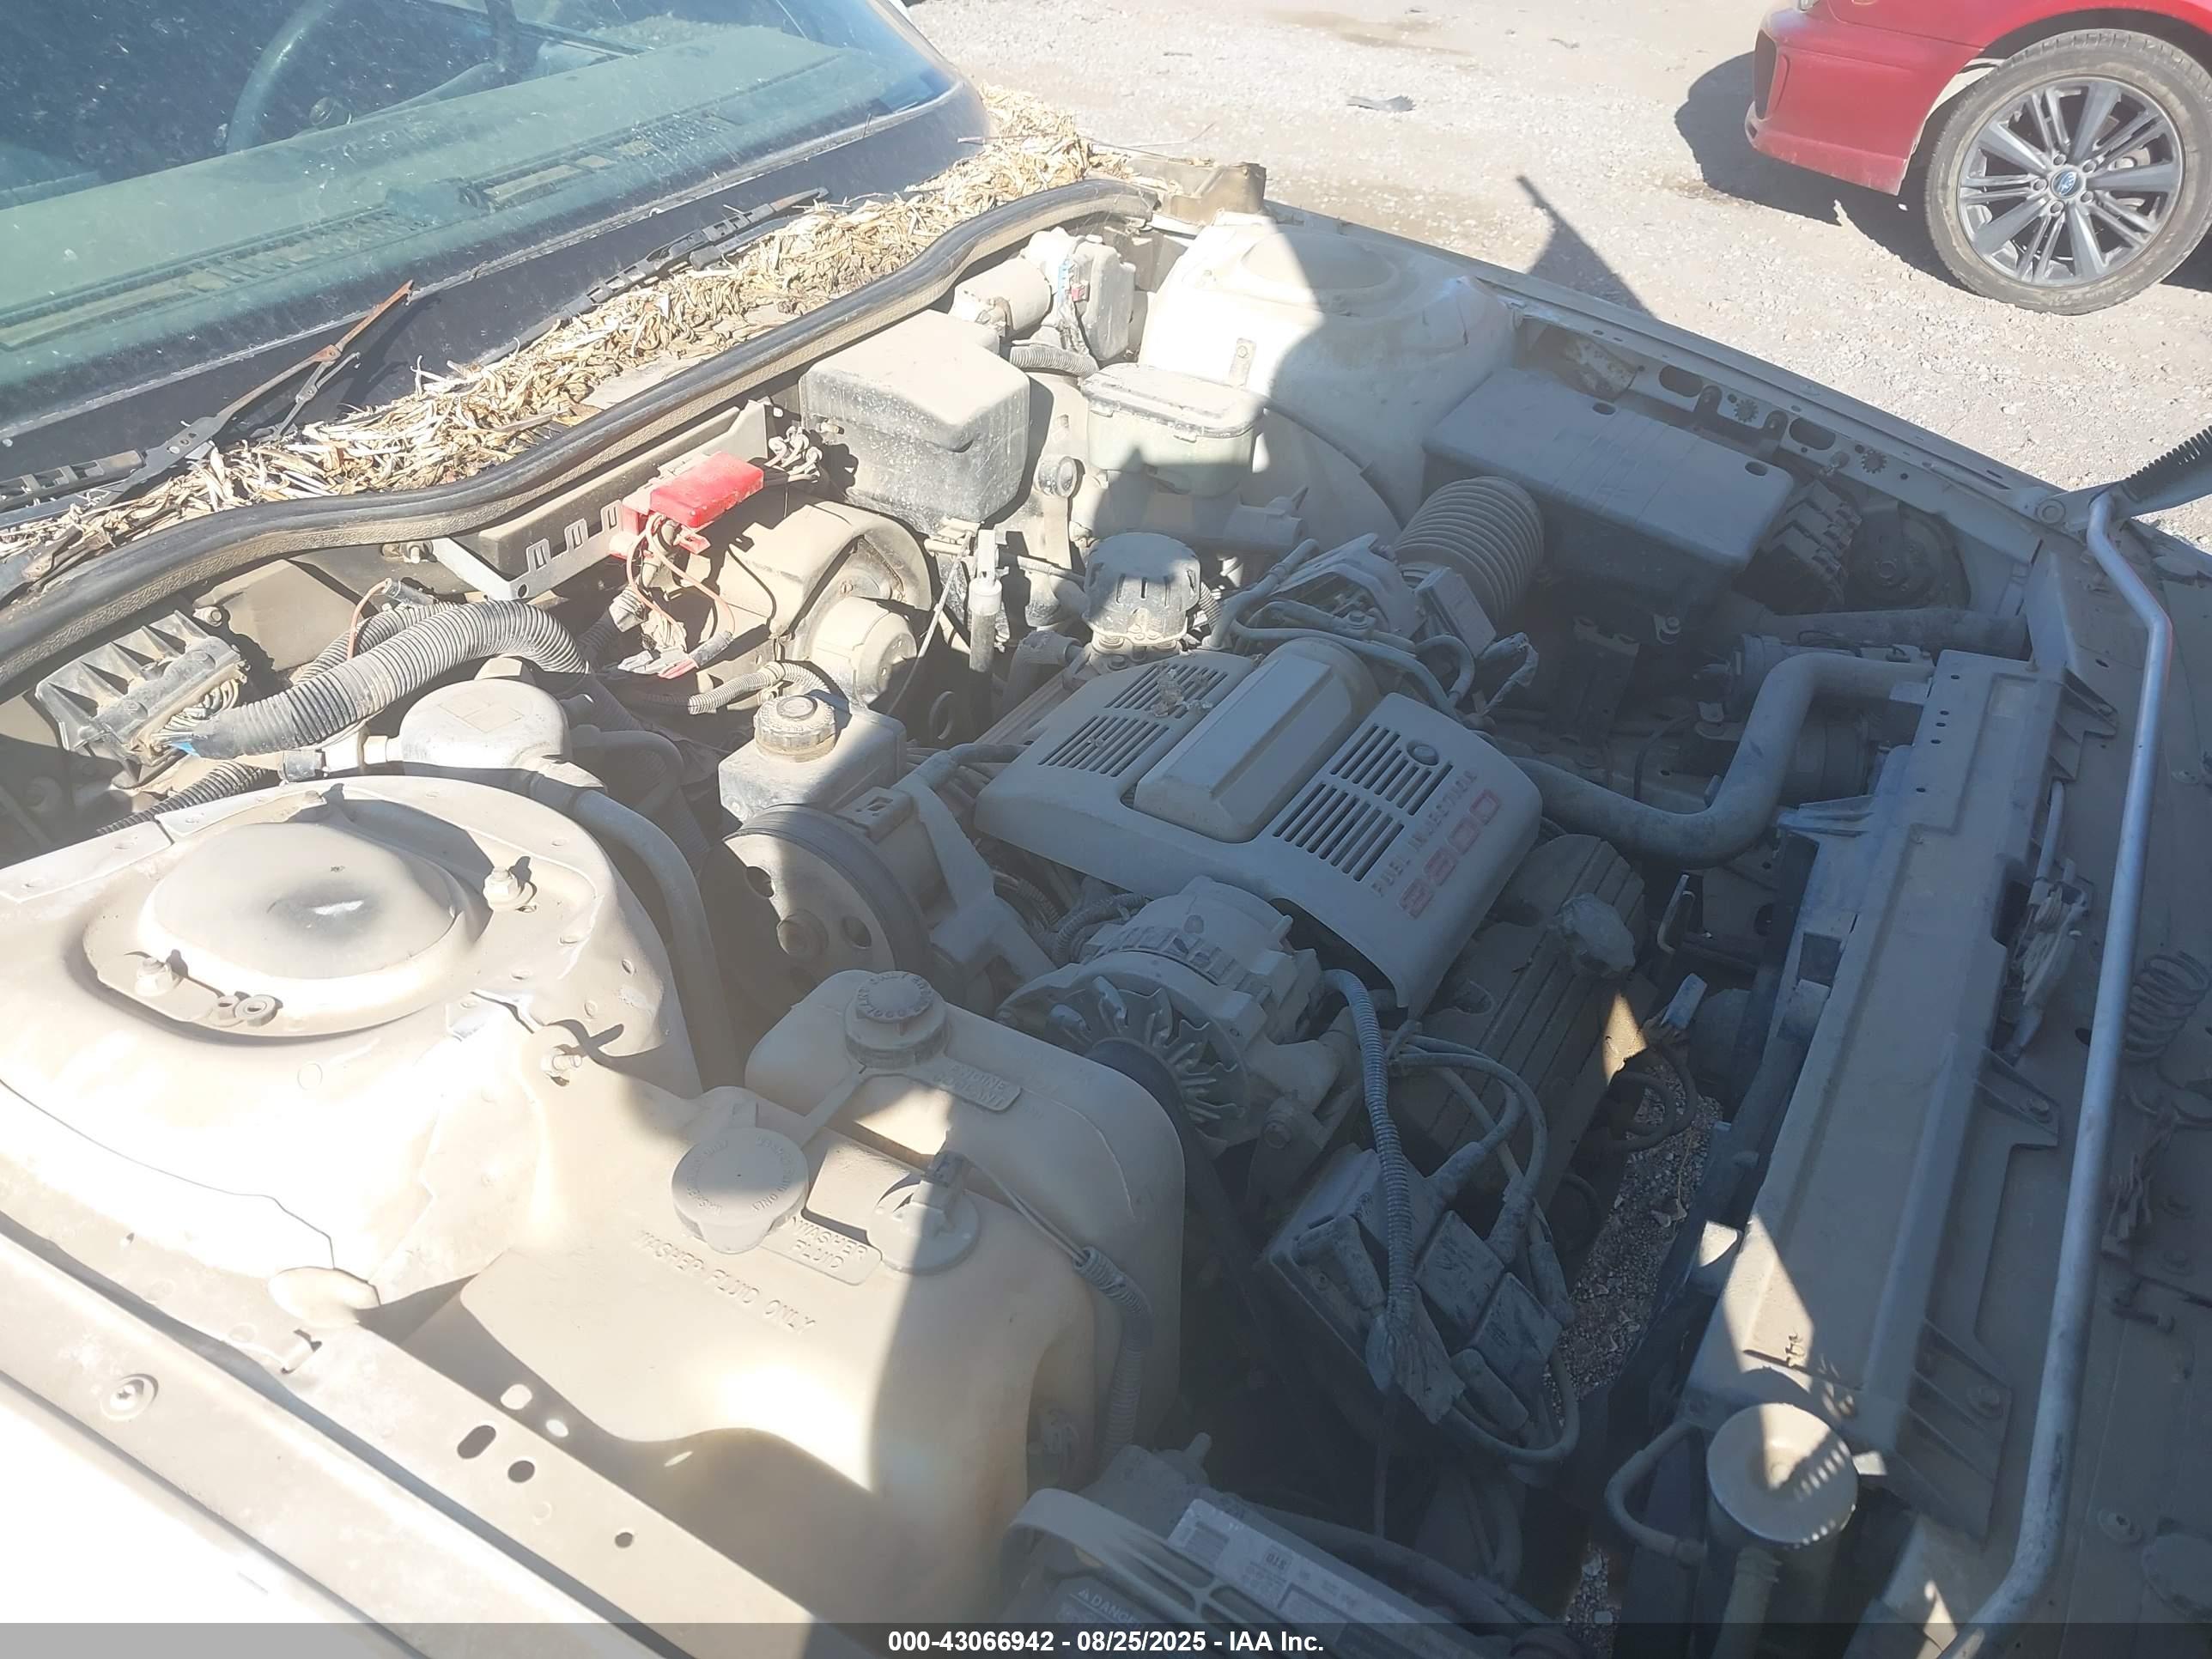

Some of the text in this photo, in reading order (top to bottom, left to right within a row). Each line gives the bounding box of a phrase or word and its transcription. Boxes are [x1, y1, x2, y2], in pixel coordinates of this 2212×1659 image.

[1371, 855, 1411, 897] FUEL
[1396, 788, 1501, 921] 3800
[793, 1216, 868, 1260] WASHER
[795, 1238, 845, 1269] FLUID
[638, 1230, 817, 1334] WASHER FLUID ONLY
